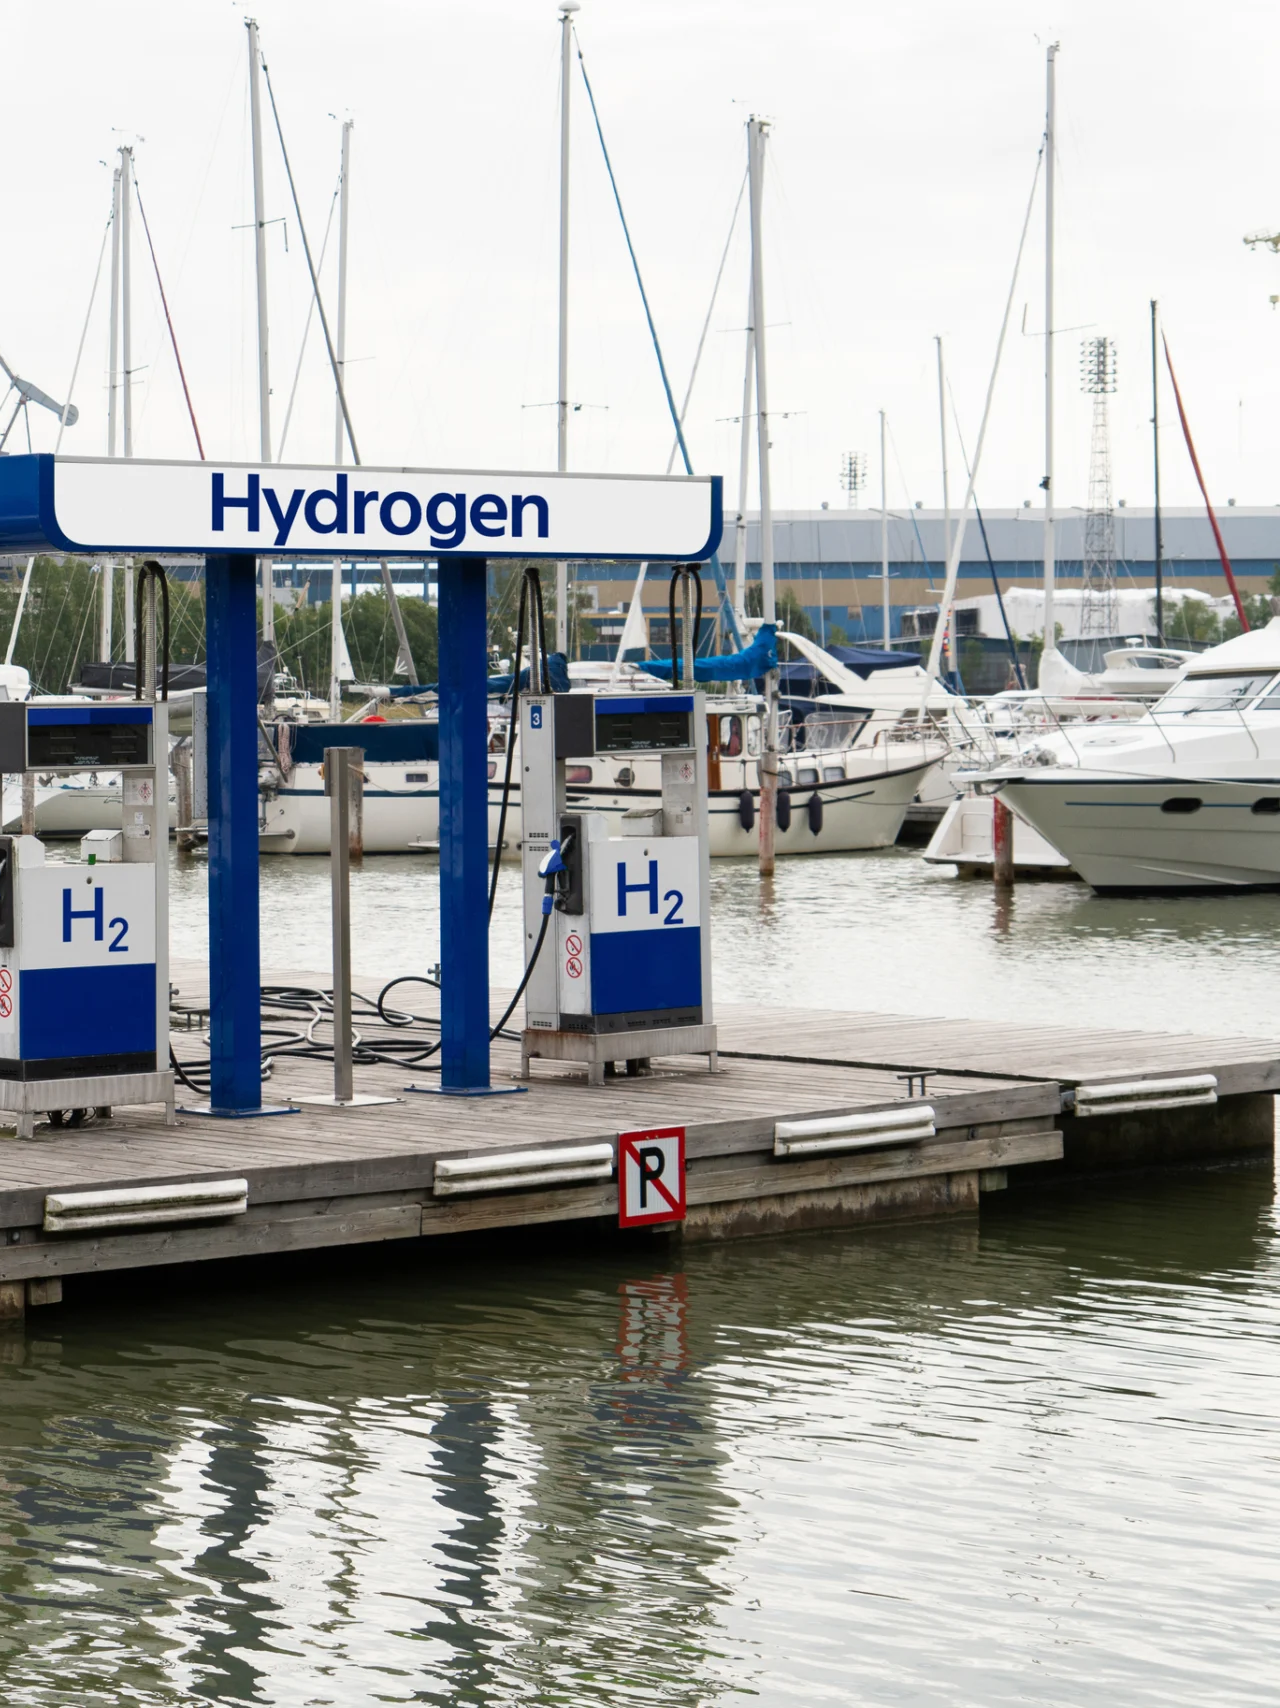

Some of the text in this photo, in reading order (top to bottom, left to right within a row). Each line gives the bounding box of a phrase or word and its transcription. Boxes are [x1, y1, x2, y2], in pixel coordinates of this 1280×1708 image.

[211, 473, 548, 549] Hydrogen
[532, 713, 540, 726] 3
[639, 1146, 666, 1208] P
